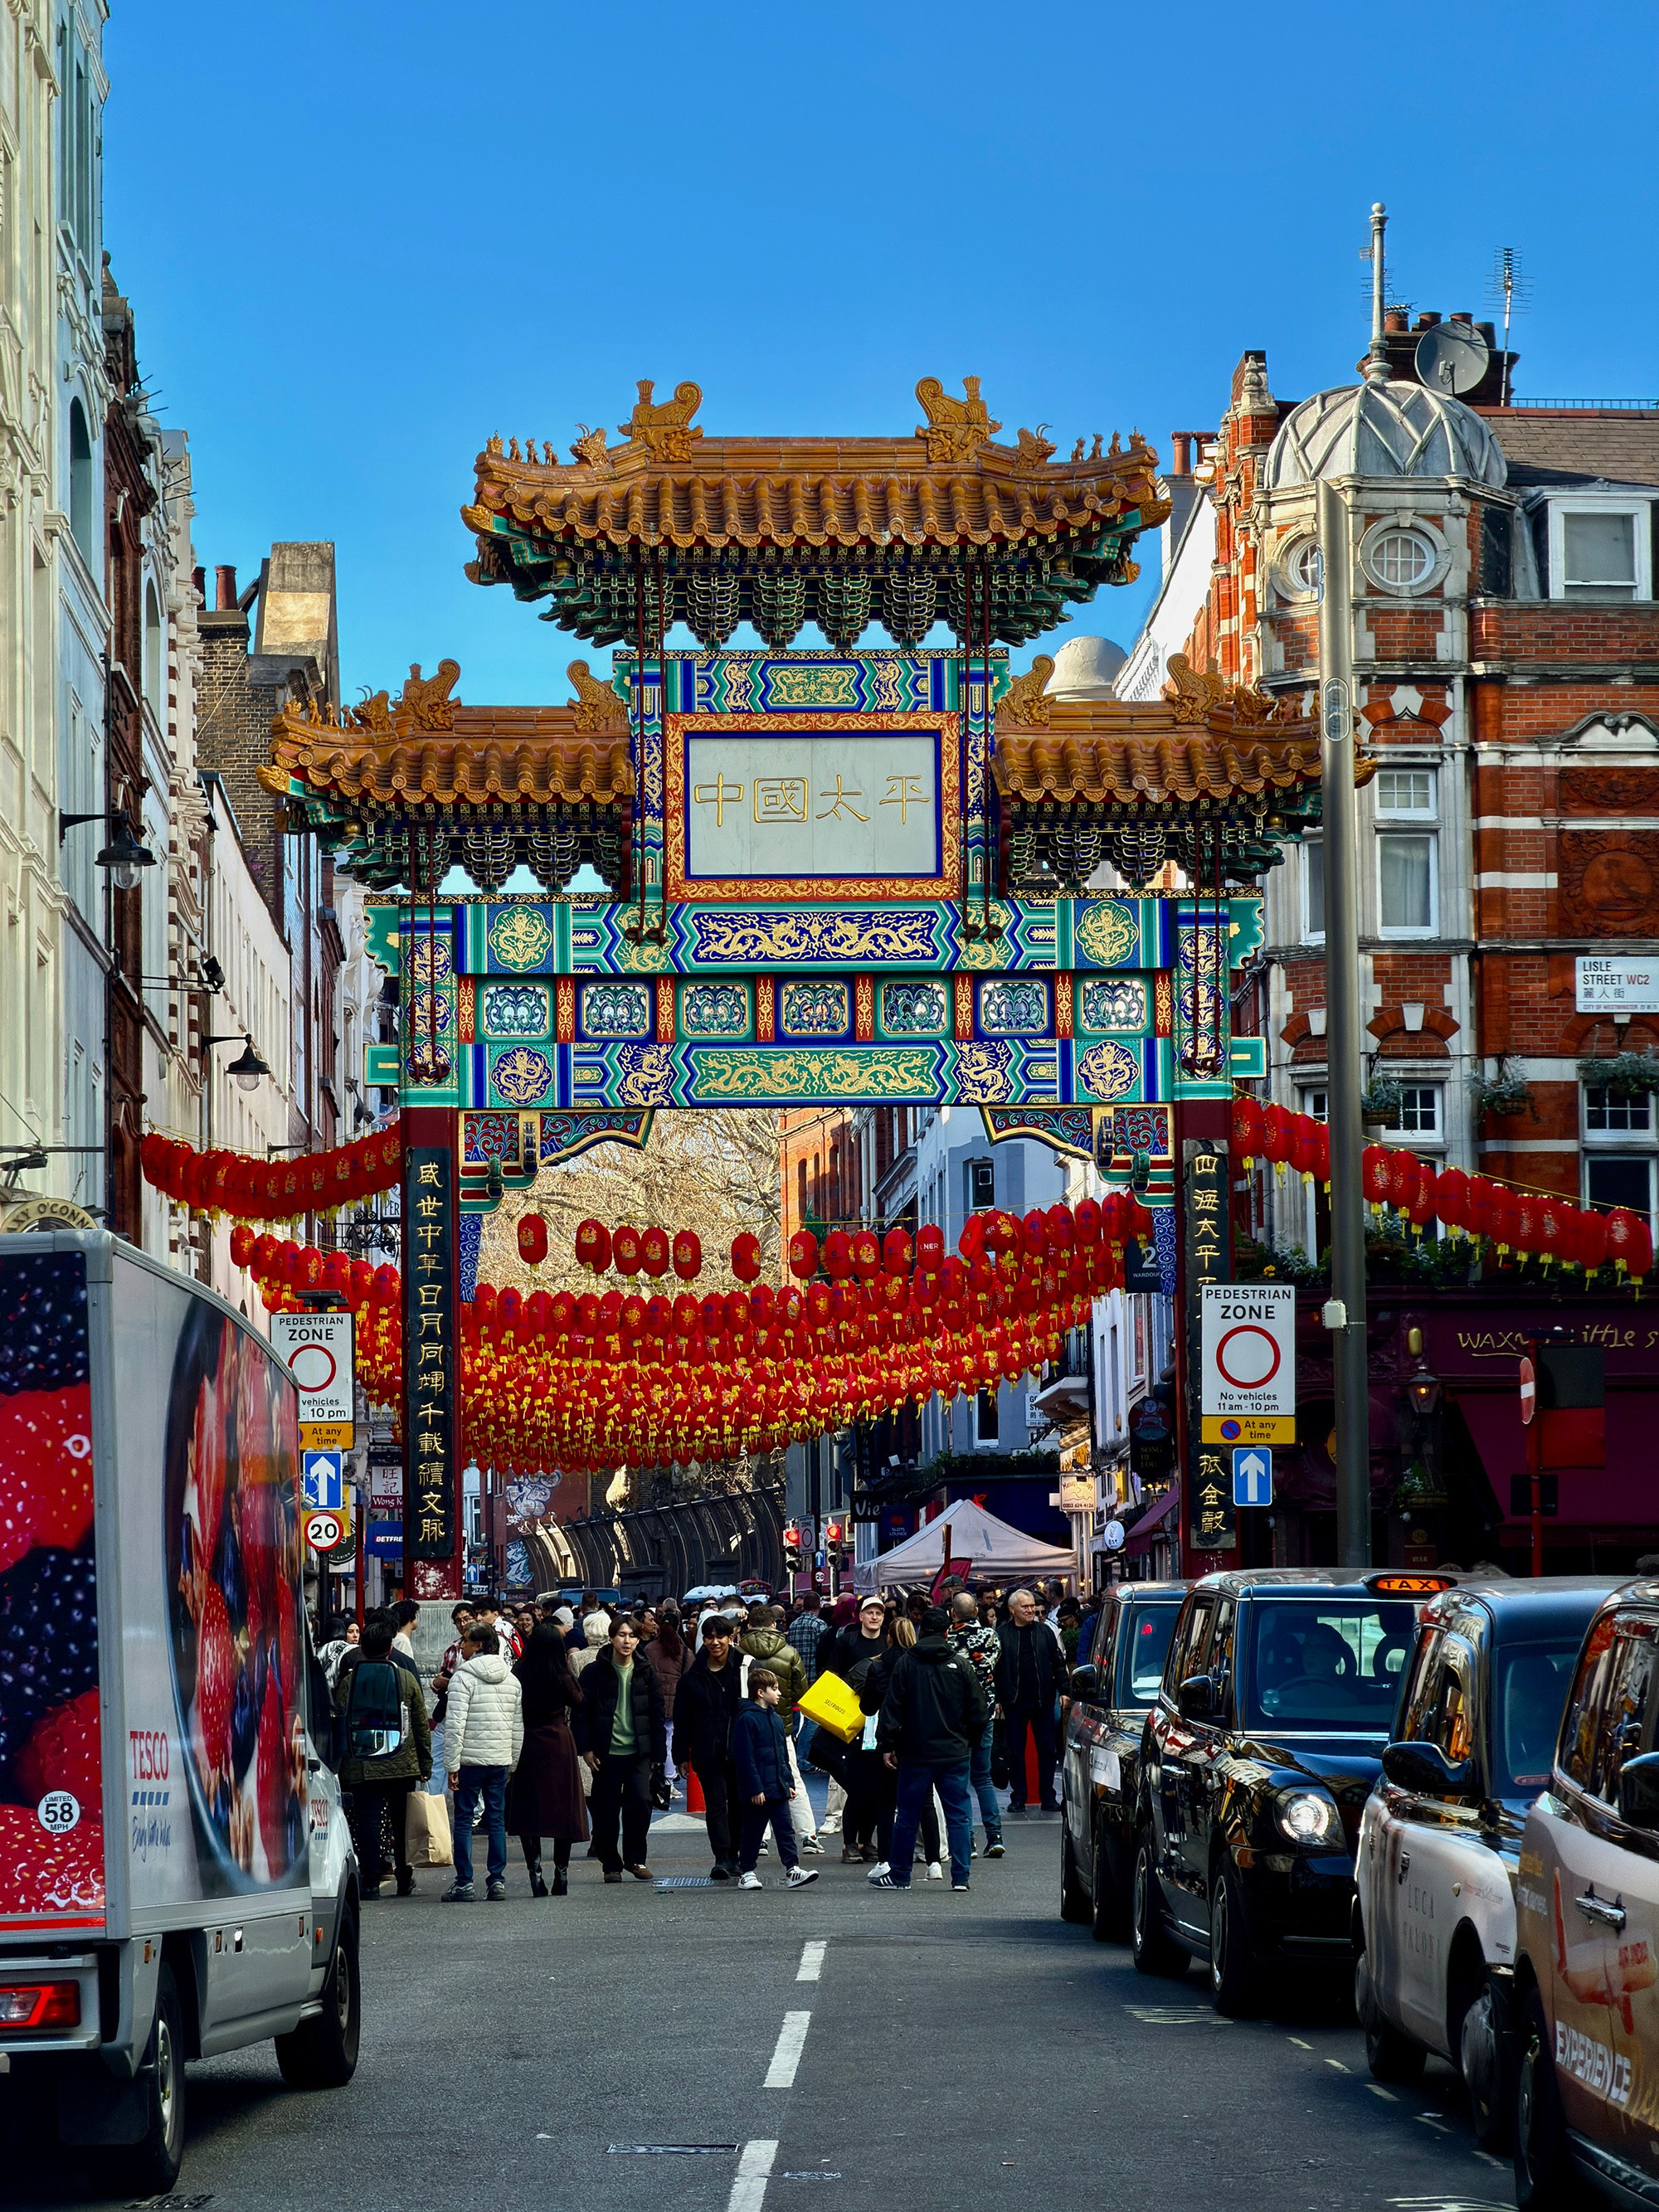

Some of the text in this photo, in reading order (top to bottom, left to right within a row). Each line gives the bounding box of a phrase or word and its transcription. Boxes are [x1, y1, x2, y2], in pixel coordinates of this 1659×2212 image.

[693, 772, 931, 827] 中國太平
[1583, 961, 1612, 971] LISLE
[1583, 975, 1650, 984] STREET WC2
[37, 1202, 94, 1230] O'CONN
[1205, 1289, 1292, 1300] PEDESTRIAN
[1220, 1305, 1276, 1320] ZONE
[279, 1317, 344, 1326] PEDESTRIAN
[288, 1328, 334, 1341] ZONE
[302, 1398, 339, 1406] vehicles
[1220, 1392, 1277, 1401] No vehicles
[1218, 1403, 1226, 1411] 11
[1250, 1403, 1262, 1411] 10
[1264, 1403, 1279, 1412] pm
[310, 1408, 324, 1417] 10
[328, 1410, 347, 1420] pm
[1244, 1420, 1277, 1431] At any
[312, 1427, 342, 1438] At any
[1249, 1431, 1271, 1439] time
[382, 1467, 399, 1479] 旺
[382, 1481, 399, 1494] 記
[373, 1497, 395, 1506] Wong
[310, 1524, 338, 1539] 20
[1383, 1579, 1444, 1590] TAXI
[824, 1699, 846, 1714] SELFRIDGES
[129, 1730, 169, 1782] TESCO
[44, 1802, 74, 1824] 58
[1555, 2020, 1631, 2104] EXPERIENCE
